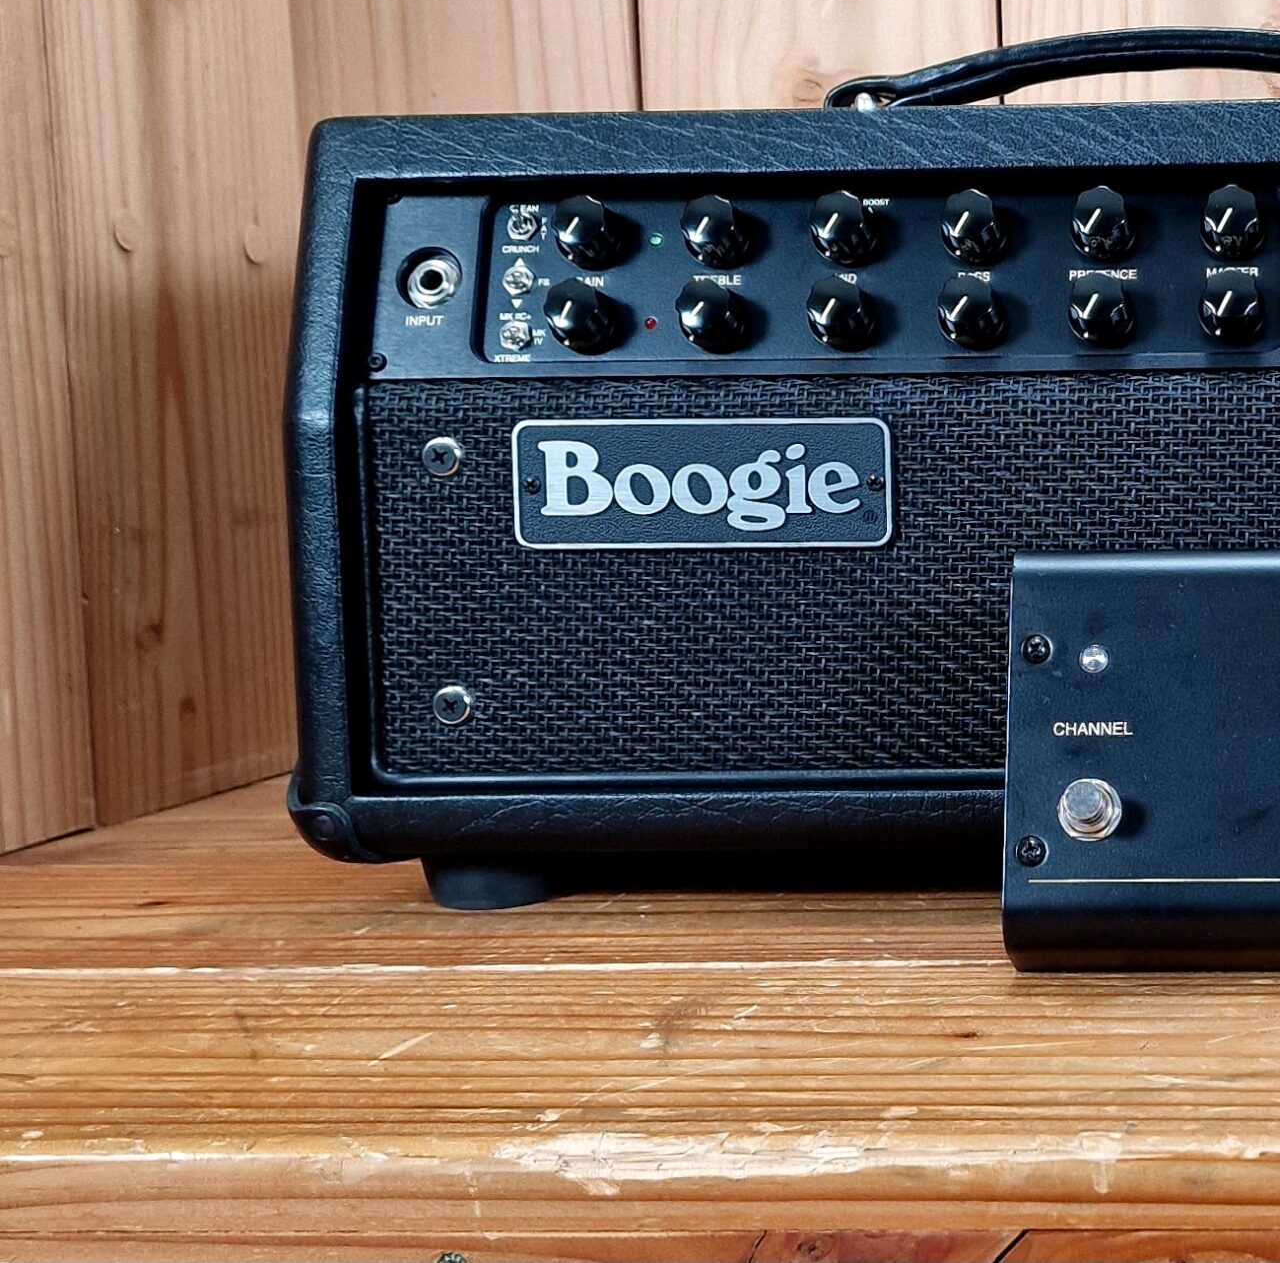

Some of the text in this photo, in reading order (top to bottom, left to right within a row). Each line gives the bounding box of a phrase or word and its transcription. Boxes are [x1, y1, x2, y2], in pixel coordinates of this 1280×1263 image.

[862, 198, 890, 206] BOOST
[509, 204, 539, 213] CEAN
[502, 245, 540, 254] CRUNCH
[1068, 269, 1138, 281] PRENCE
[1206, 267, 1259, 278] MAER
[576, 277, 604, 287] AIN
[405, 315, 443, 327] INPUT
[494, 354, 531, 363] XTREME
[537, 440, 861, 531] Boogie
[1052, 721, 1134, 737] CHANNEL
